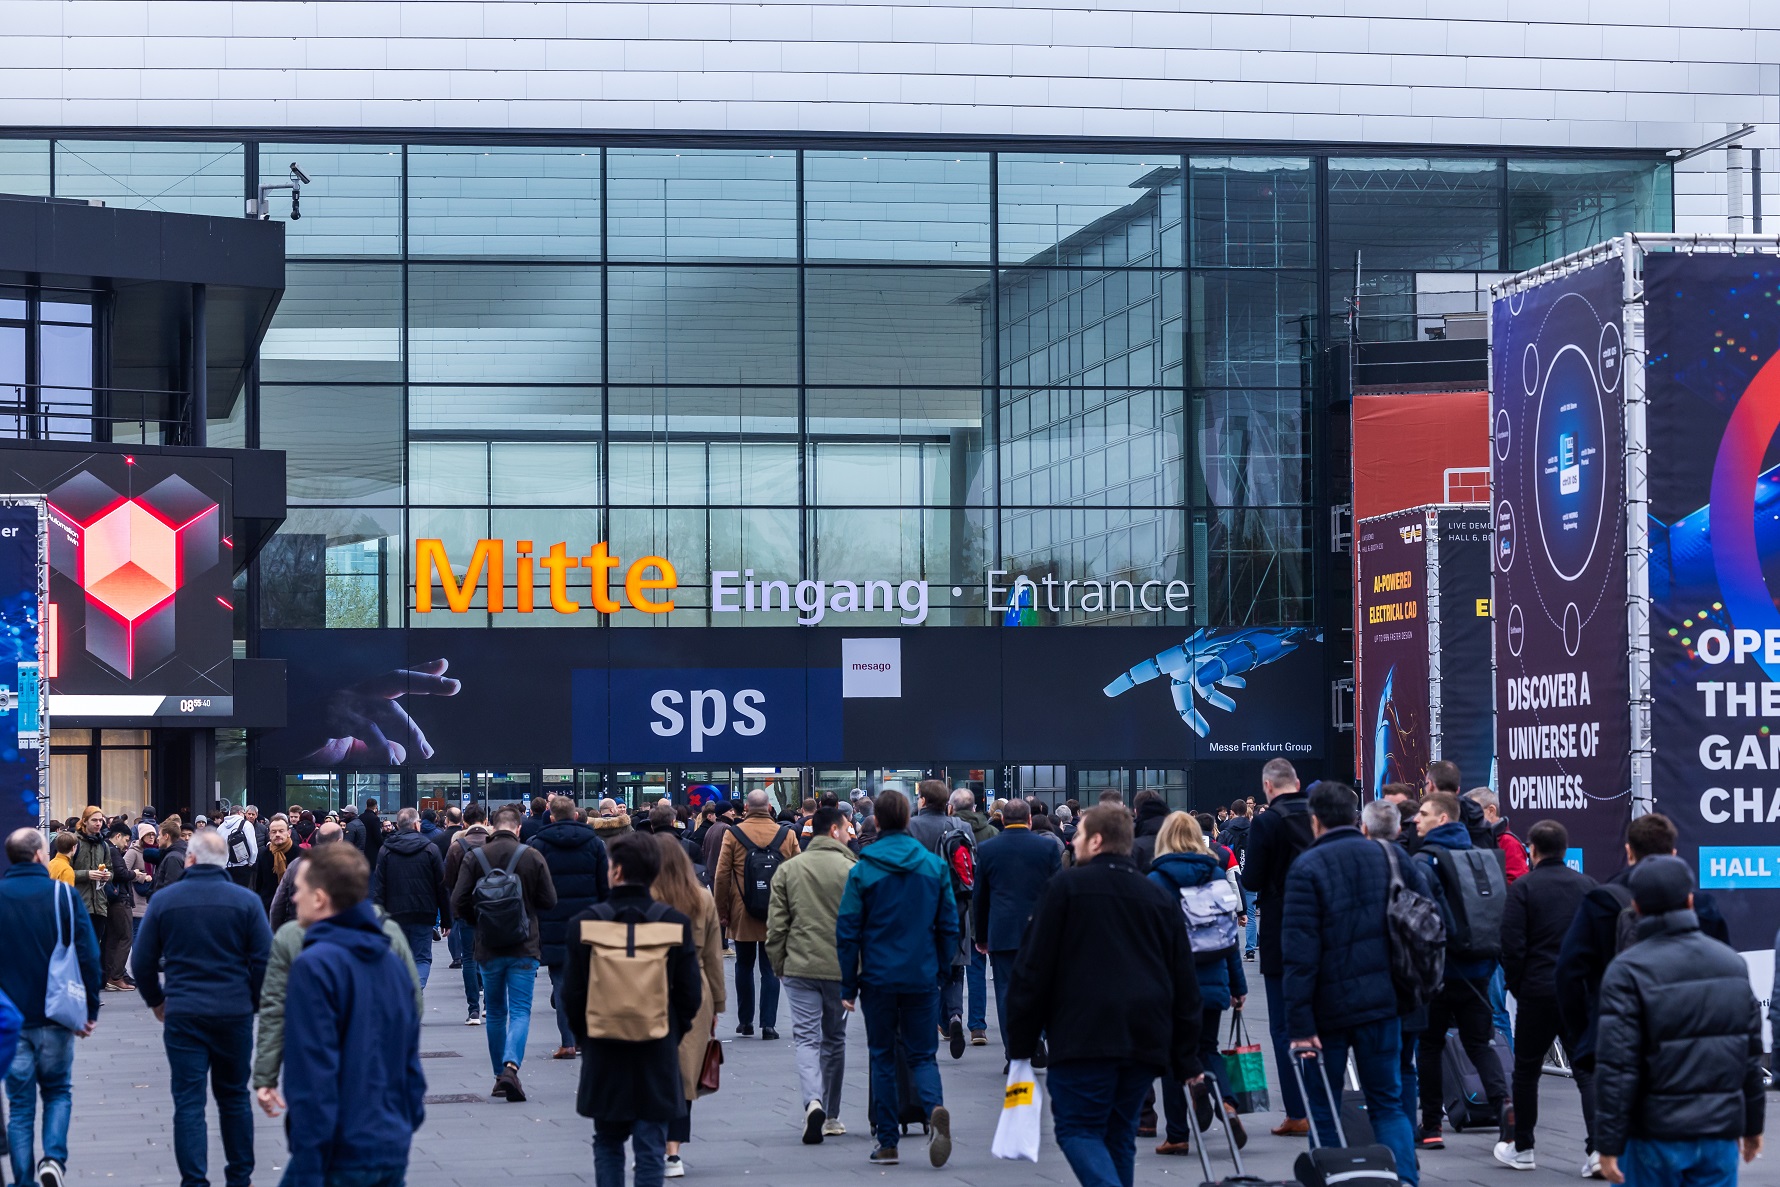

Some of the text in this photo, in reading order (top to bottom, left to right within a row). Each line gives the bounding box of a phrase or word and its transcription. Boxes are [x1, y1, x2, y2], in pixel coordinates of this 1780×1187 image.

[416, 538, 678, 614] Mitte
[1374, 570, 1412, 593] AI-POWERED
[712, 569, 1190, 625] Eingang Entrance
[1370, 601, 1417, 624] ELECTRICAL CAD
[852, 661, 891, 672] mesago
[1507, 671, 1591, 711] DISCOVER A
[650, 689, 766, 752] sps
[1209, 742, 1312, 753] Messe Frankfurt Group
[1508, 722, 1600, 760] UNIVERSE OF
[1509, 774, 1588, 810] OPENNESS.
[1710, 857, 1771, 876] HALL
